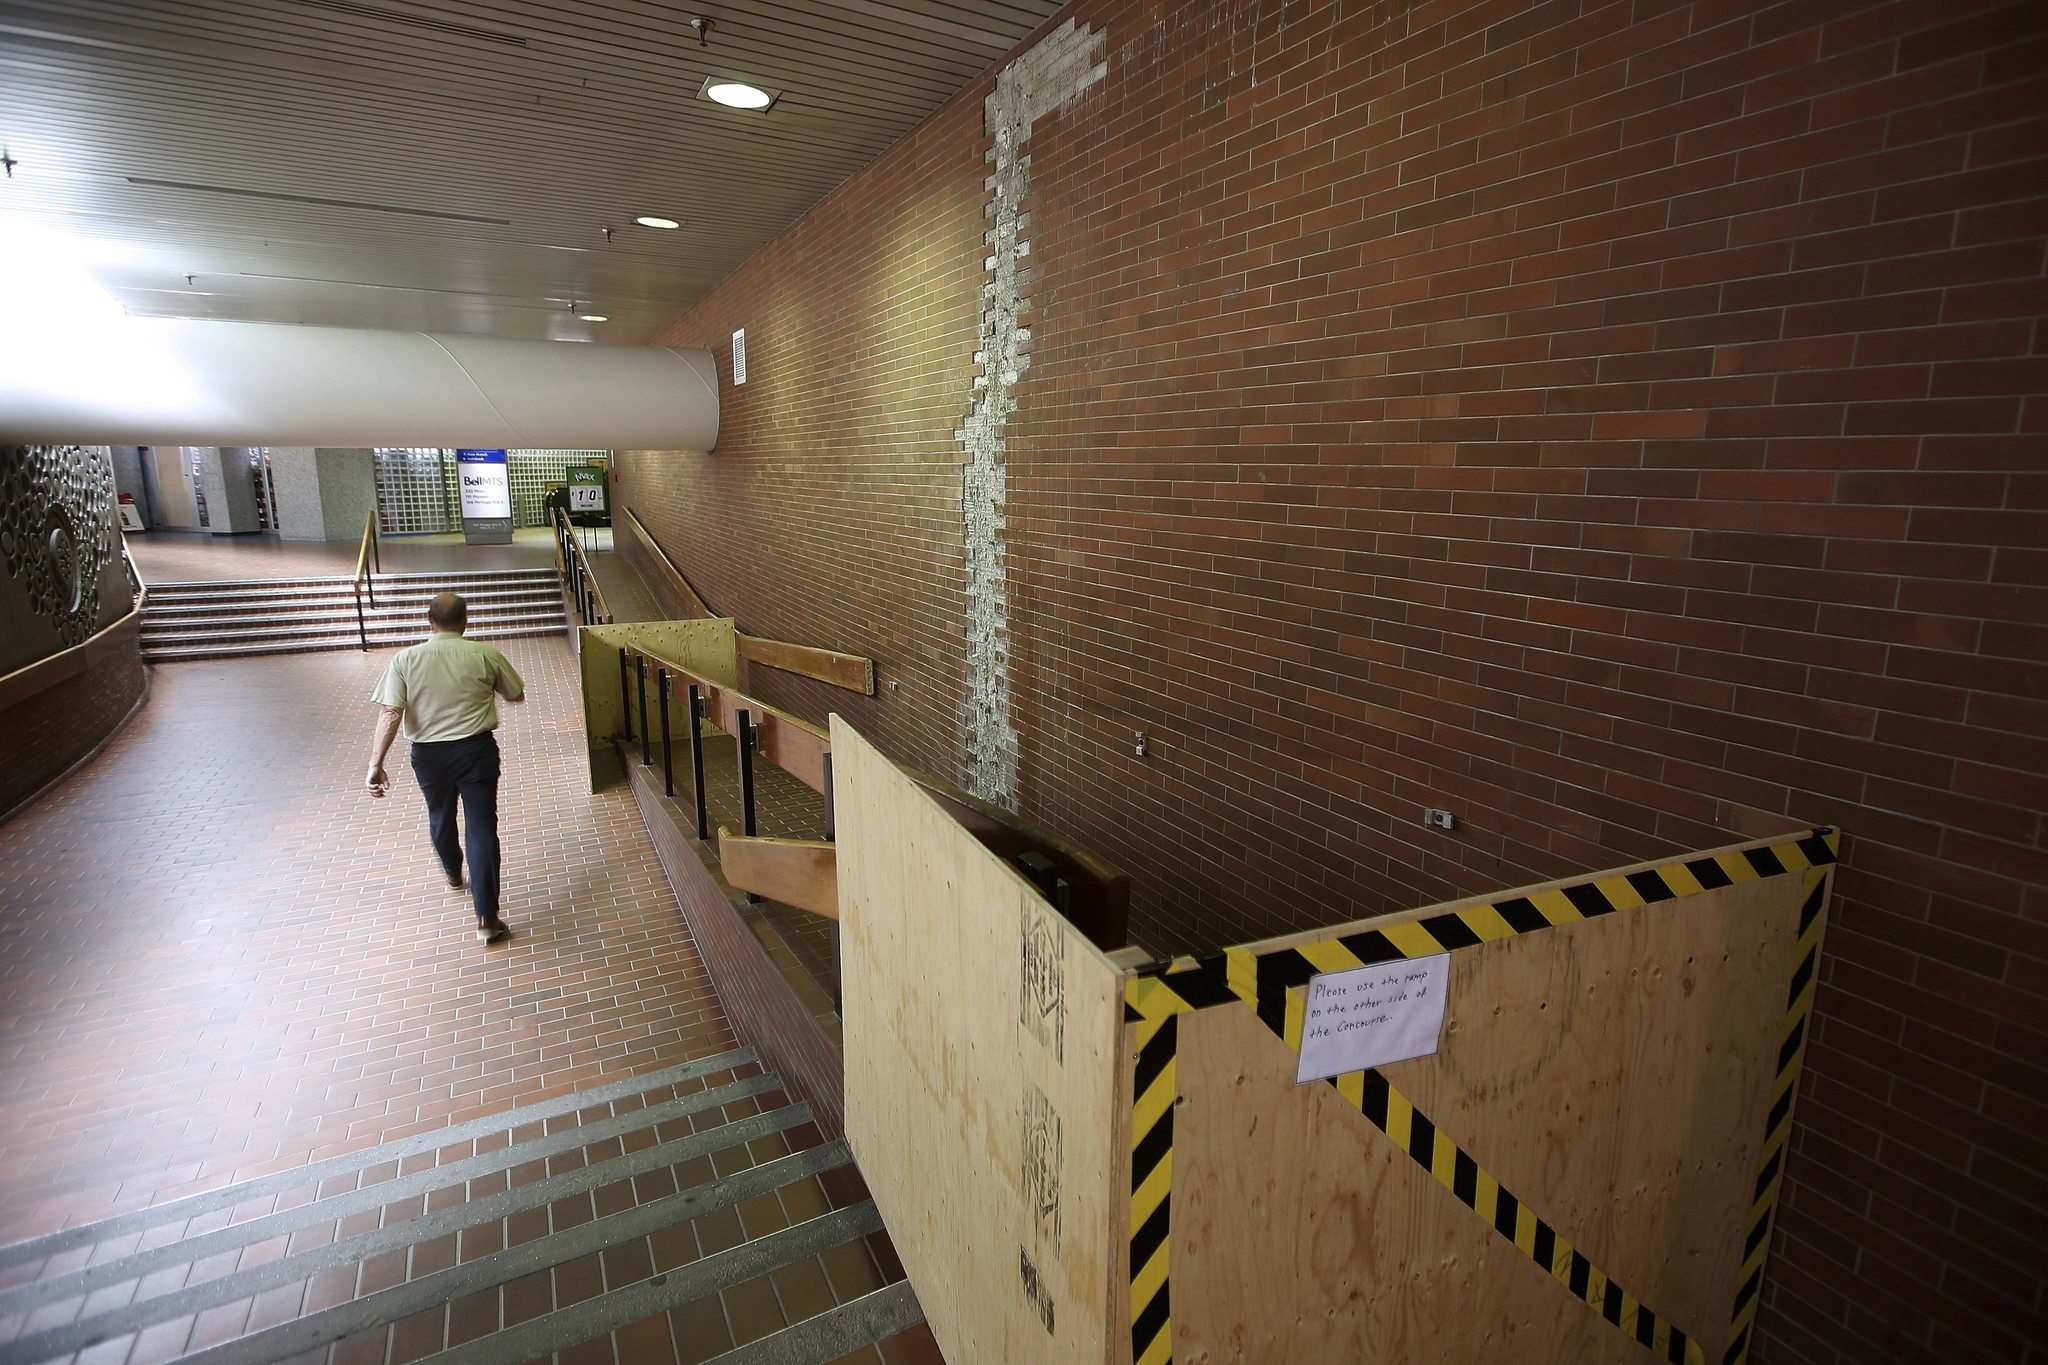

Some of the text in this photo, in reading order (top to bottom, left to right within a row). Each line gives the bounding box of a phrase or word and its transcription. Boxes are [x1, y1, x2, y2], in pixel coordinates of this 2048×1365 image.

[1315, 971, 1429, 1000] Please use the ramp
[1311, 987, 1428, 1019] on the other side of
[1309, 1026, 1330, 1039] the
